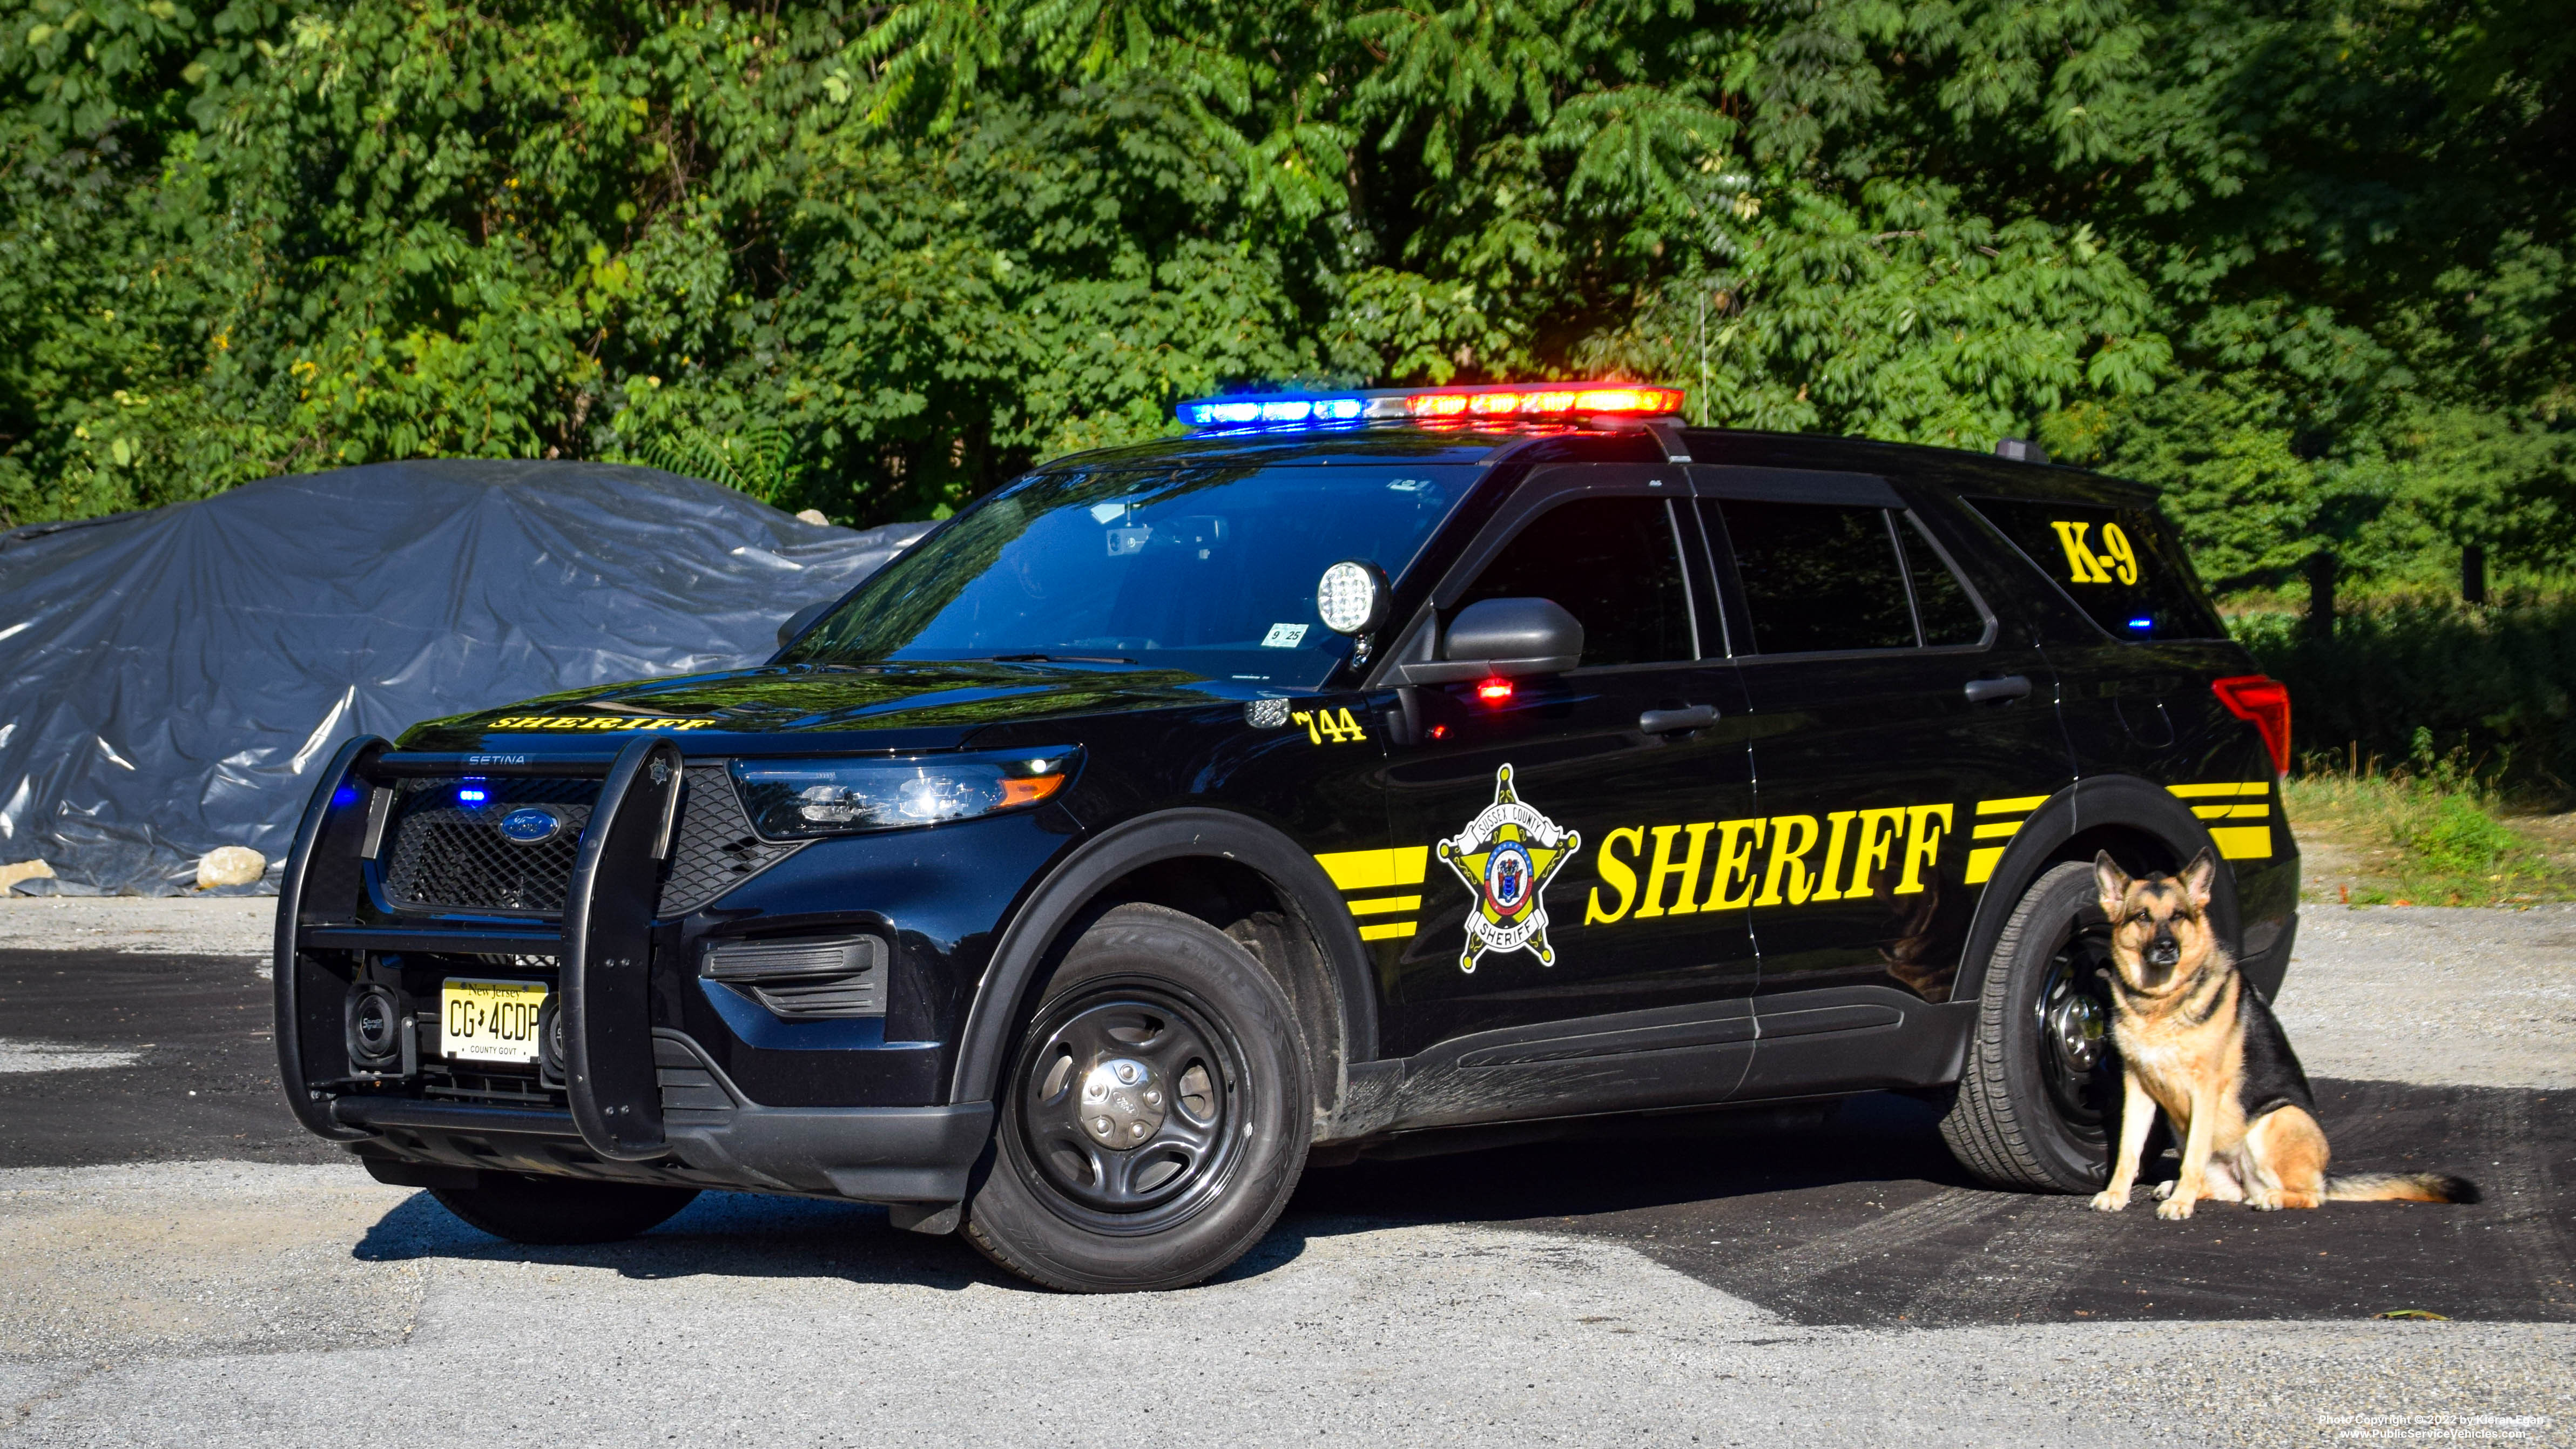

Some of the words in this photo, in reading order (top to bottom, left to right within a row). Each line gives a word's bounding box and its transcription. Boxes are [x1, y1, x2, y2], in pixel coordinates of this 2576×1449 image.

[2051, 521, 2137, 585] K-9
[1272, 631, 1280, 639] 9
[1286, 631, 1301, 640] 25
[488, 717, 716, 730] SHERIFF
[1292, 707, 1367, 745] 744
[469, 756, 525, 765] SETINA
[1479, 807, 1507, 835] SUSSEX
[1513, 807, 1541, 833] COUNTY
[1584, 803, 1953, 926] SHERIFF
[1480, 919, 1530, 946] SHERIFF
[468, 984, 490, 996] New
[491, 985, 521, 1000] Jersey
[450, 1000, 475, 1037] CG
[489, 1002, 540, 1041] 4CDP
[470, 1046, 497, 1055] COUNTY
[498, 1047, 517, 1055] GOVT
